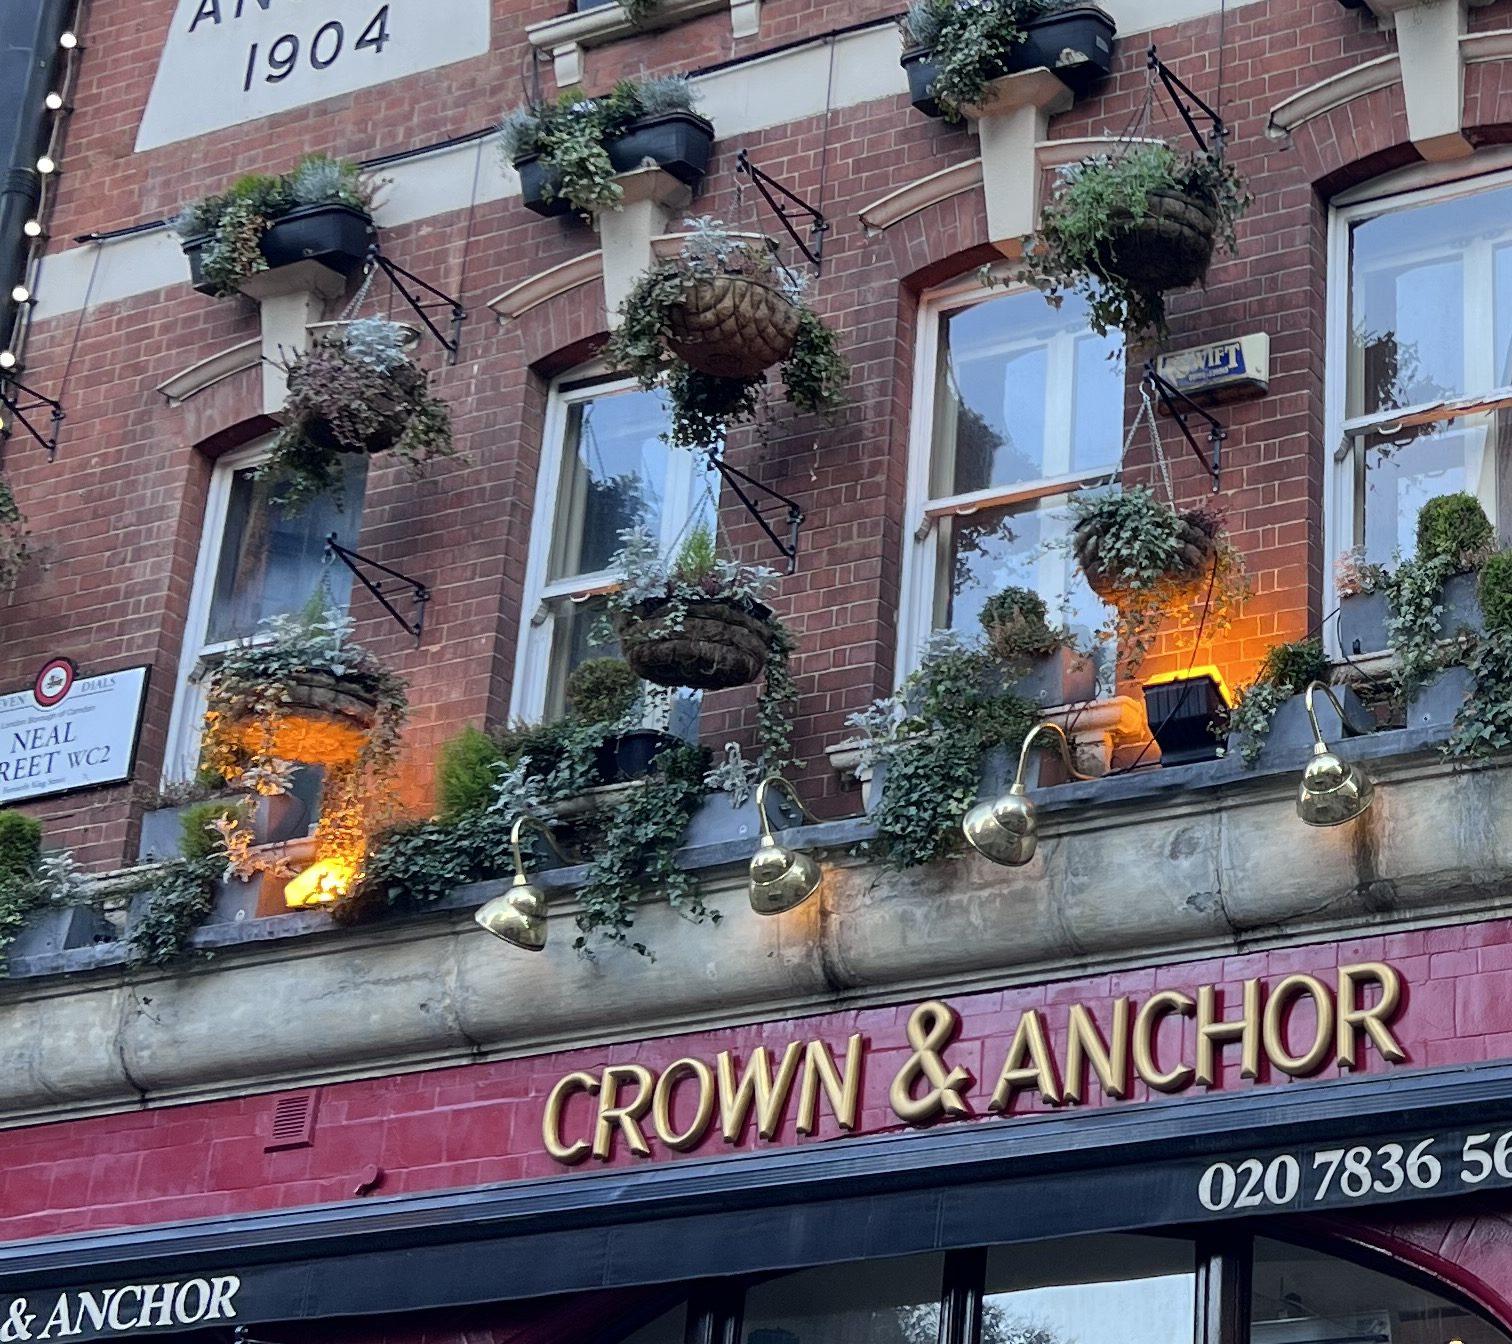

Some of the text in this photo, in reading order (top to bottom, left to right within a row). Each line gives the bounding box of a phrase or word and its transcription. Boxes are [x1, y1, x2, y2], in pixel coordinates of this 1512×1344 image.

[243, 3, 392, 92] 1904
[81, 676, 117, 694] DIALS
[10, 721, 77, 754] NEAL
[68, 745, 112, 769] WC2
[543, 960, 1407, 1164] CROWN & ANCHOR
[1198, 1154, 1301, 1212] 020
[1312, 1137, 1442, 1201] 7836
[0, 1274, 242, 1344] & ANCHOR
